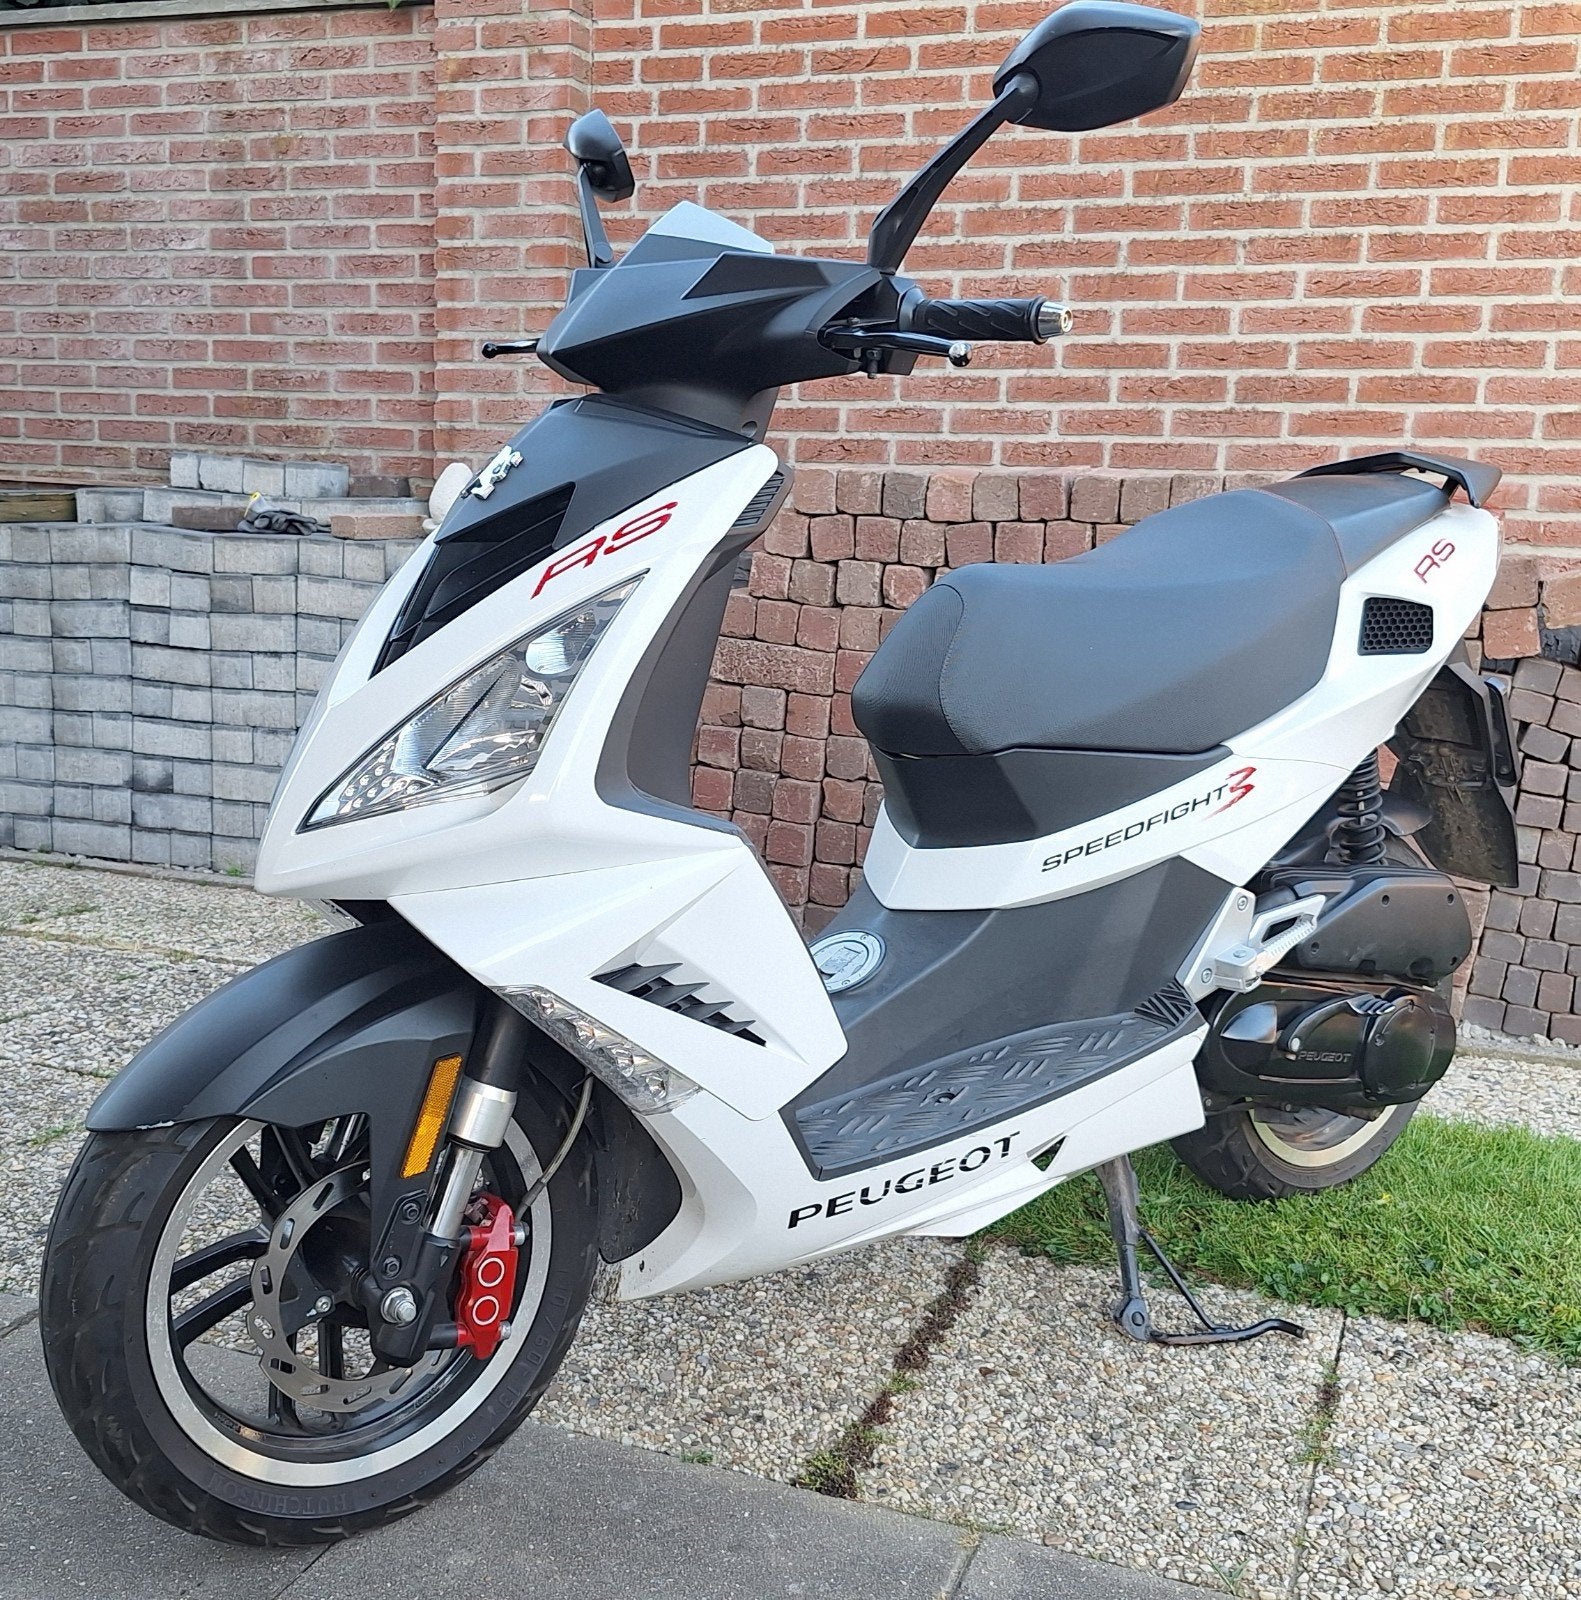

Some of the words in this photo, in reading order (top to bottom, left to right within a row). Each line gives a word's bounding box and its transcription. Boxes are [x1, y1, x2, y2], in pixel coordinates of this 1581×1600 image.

[530, 501, 678, 600] RS
[1413, 538, 1456, 584] RS
[1041, 783, 1229, 873] SPEEDFIGHT
[1298, 1051, 1352, 1063] PEUGEOT
[787, 1130, 1021, 1230] PEUGEOT
[207, 1472, 348, 1515] HUTCHINSON
